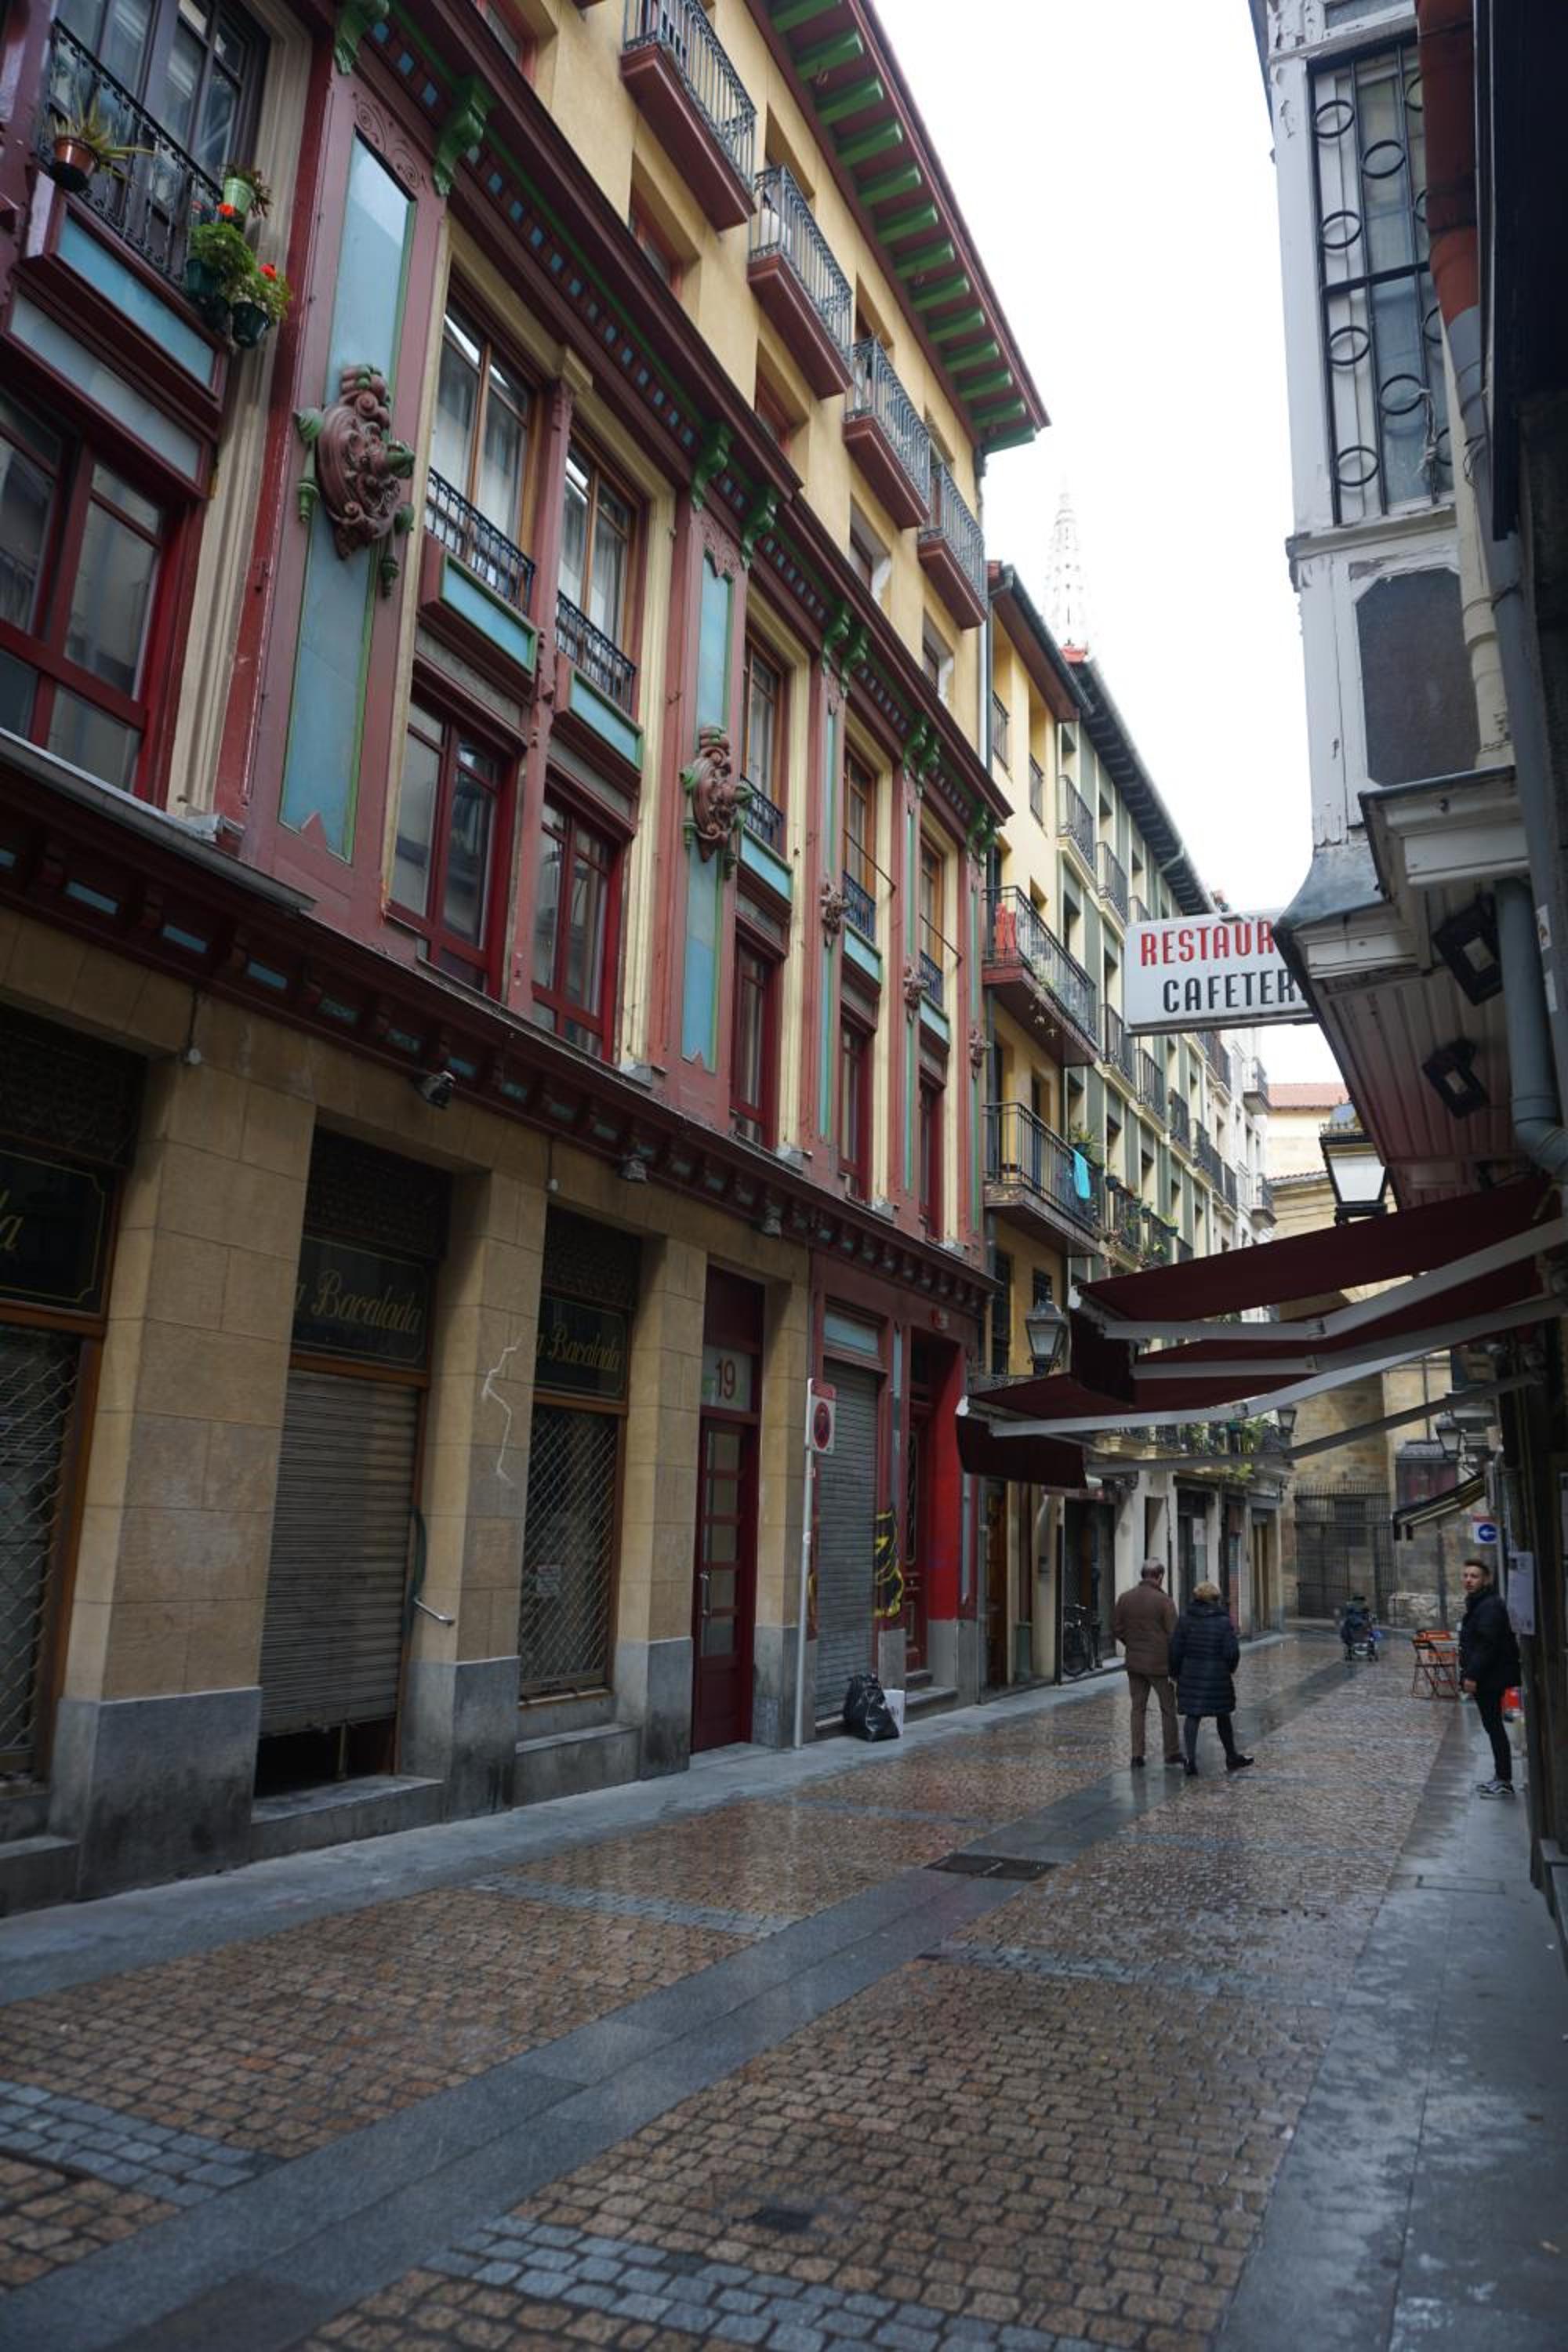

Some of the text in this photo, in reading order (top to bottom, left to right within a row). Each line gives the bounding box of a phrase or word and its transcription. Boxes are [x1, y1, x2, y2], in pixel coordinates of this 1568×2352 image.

[1142, 920, 1274, 966] RESTAUR
[1163, 970, 1305, 1013] CAFETER
[715, 1356, 736, 1400] 19
